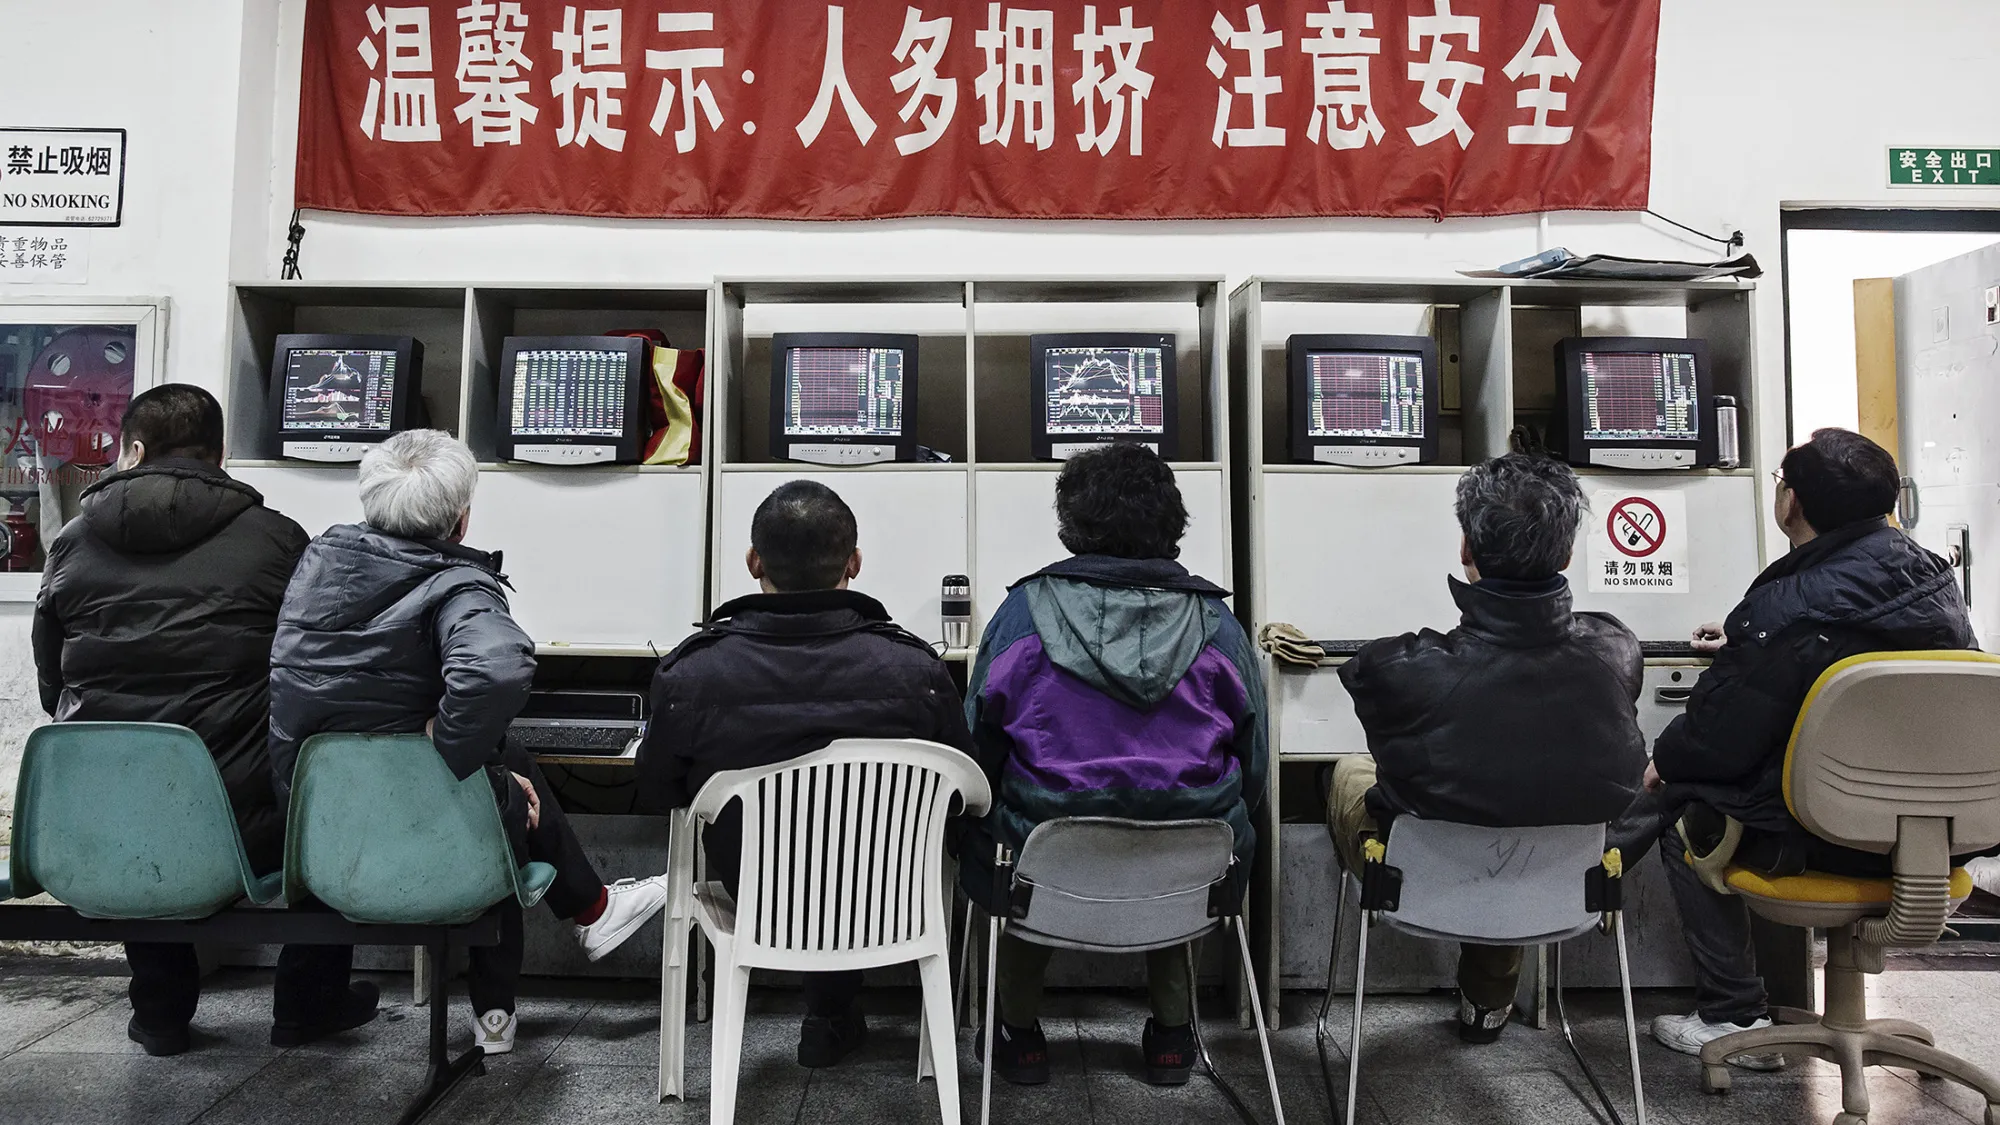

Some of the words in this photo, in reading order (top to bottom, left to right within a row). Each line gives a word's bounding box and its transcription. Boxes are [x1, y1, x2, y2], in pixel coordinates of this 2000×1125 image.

[7, 145, 112, 176] 禁止吸烟
[1899, 150, 1991, 169] 安全出口
[1911, 169, 1980, 183] EXIT
[3, 193, 27, 208] NO
[31, 193, 110, 209] SMOKING
[1604, 560, 1673, 576] 请勿吸烟
[1604, 578, 1620, 586] NO
[1623, 578, 1673, 586] SMOKING
